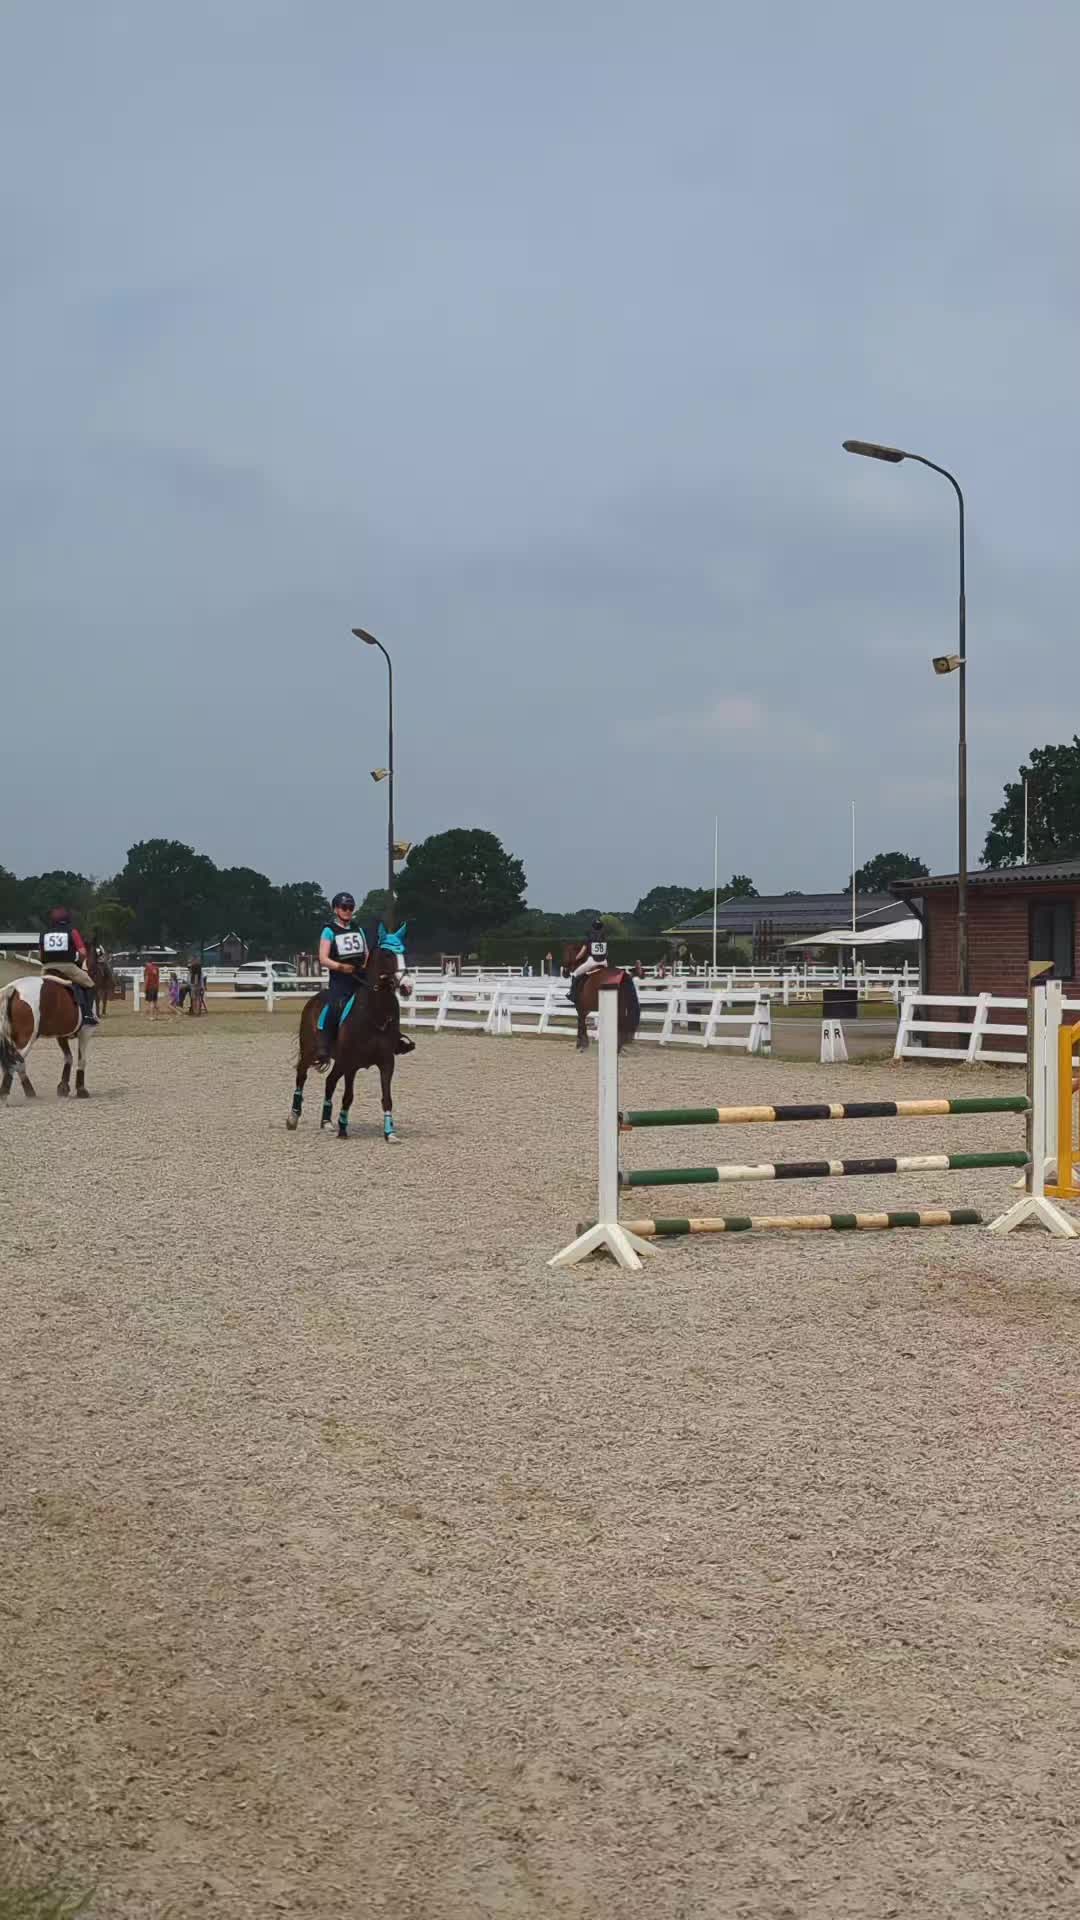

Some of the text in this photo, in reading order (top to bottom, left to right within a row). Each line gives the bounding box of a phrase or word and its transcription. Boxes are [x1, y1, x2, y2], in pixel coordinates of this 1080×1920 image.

[49, 935, 63, 947] 53
[344, 935, 360, 951] 55
[501, 1007, 508, 1016] M
[823, 1029, 830, 1039] R
[834, 1028, 841, 1039] R
